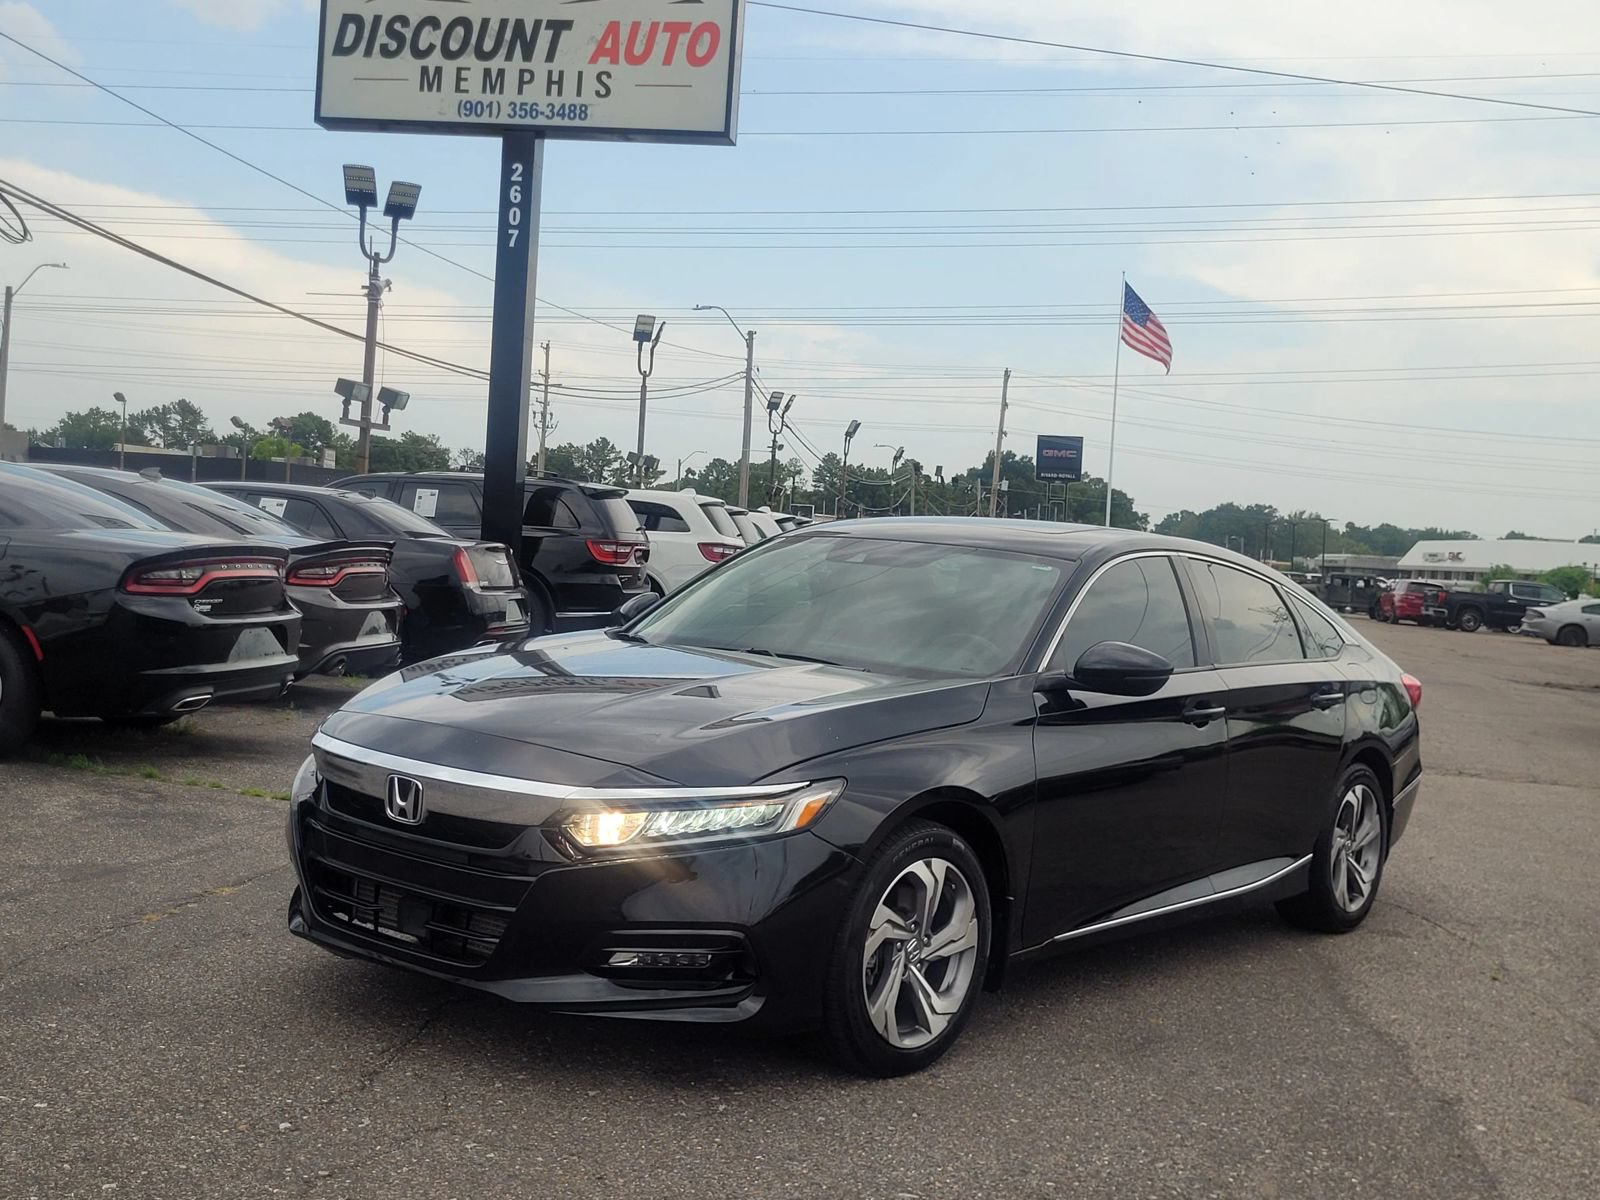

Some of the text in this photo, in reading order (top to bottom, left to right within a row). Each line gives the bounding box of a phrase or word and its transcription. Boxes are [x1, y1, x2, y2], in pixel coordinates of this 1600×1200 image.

[332, 13, 720, 67] DISCOUNT AUTO
[419, 65, 612, 98] MEMPHIS
[457, 99, 588, 121] (901) 356-3488
[508, 162, 523, 248] 2607
[1043, 449, 1077, 457] GMC
